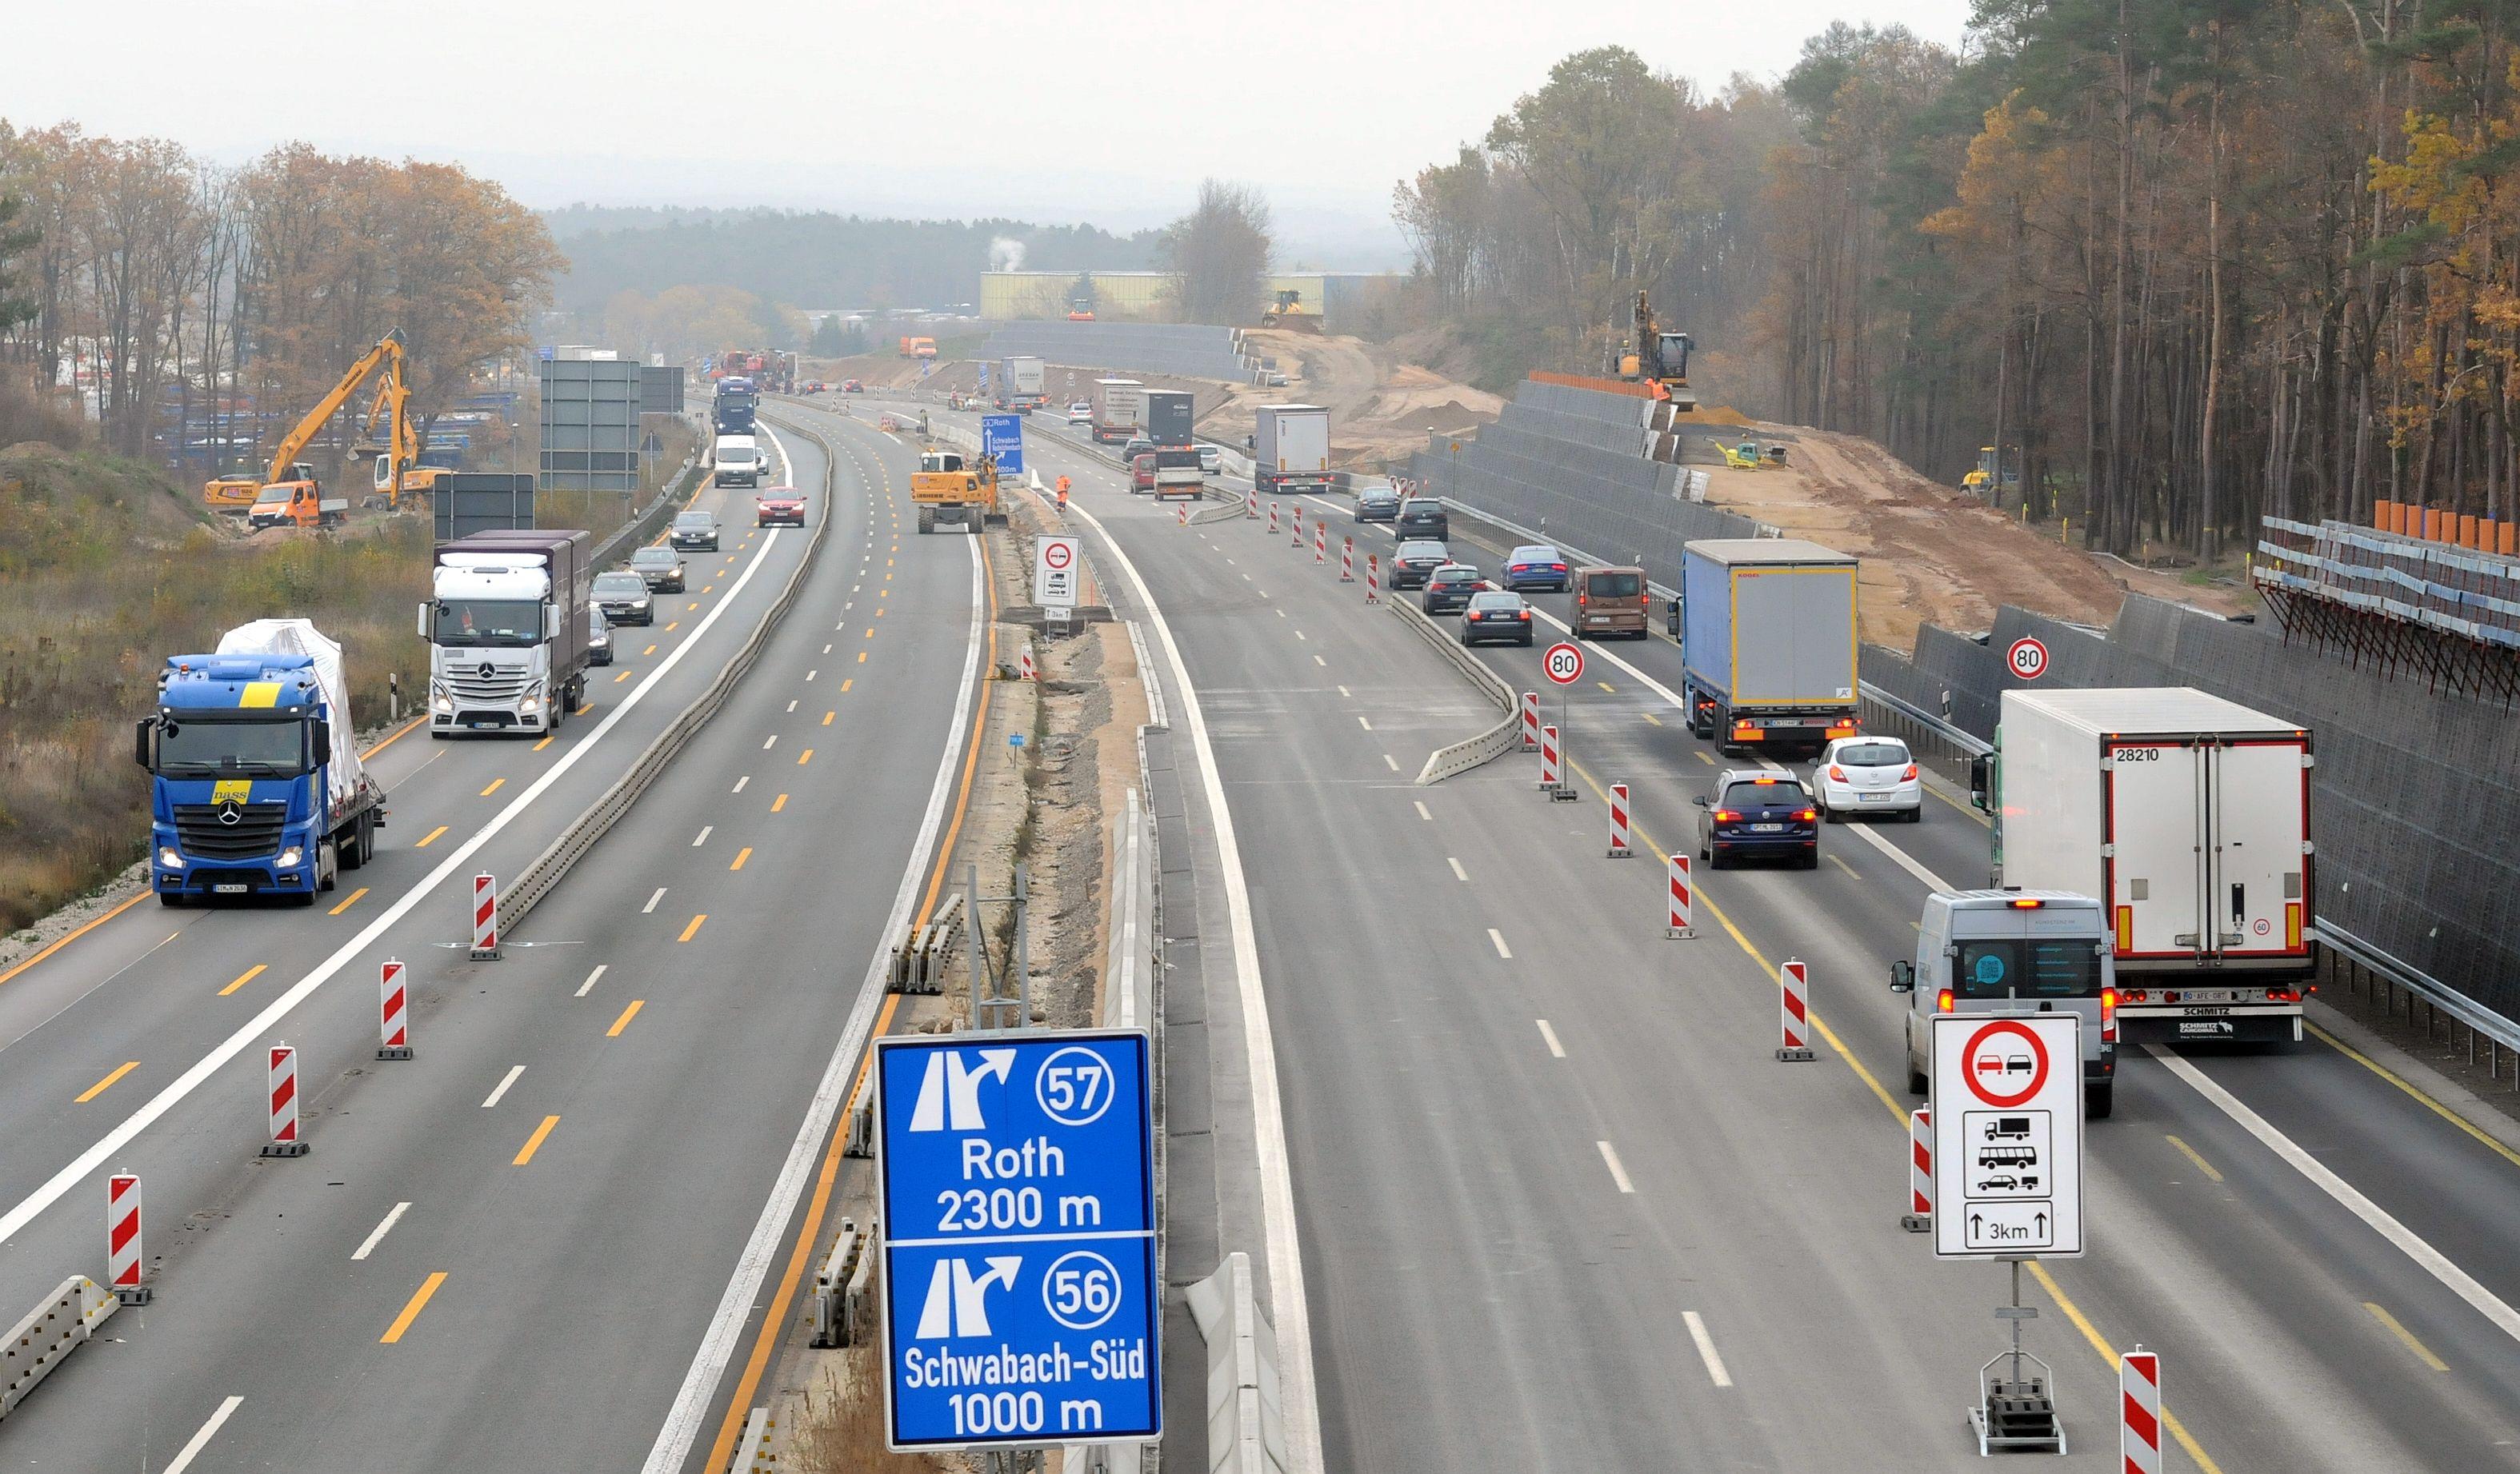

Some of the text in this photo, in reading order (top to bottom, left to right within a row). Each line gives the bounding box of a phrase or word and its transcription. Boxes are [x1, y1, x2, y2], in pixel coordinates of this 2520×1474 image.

[1553, 655, 1574, 673] 80
[2017, 649, 2039, 667] 80
[2116, 749, 2159, 762] 28210
[1048, 1066, 1102, 1111] 57
[961, 1136, 1065, 1180] Roth
[937, 1187, 1102, 1232] 2300 m
[1990, 1222, 2029, 1240] 3km
[1055, 1269, 1110, 1314] 56
[905, 1338, 1146, 1389] Schwabach-Süd
[948, 1392, 1102, 1435] 1000 m
